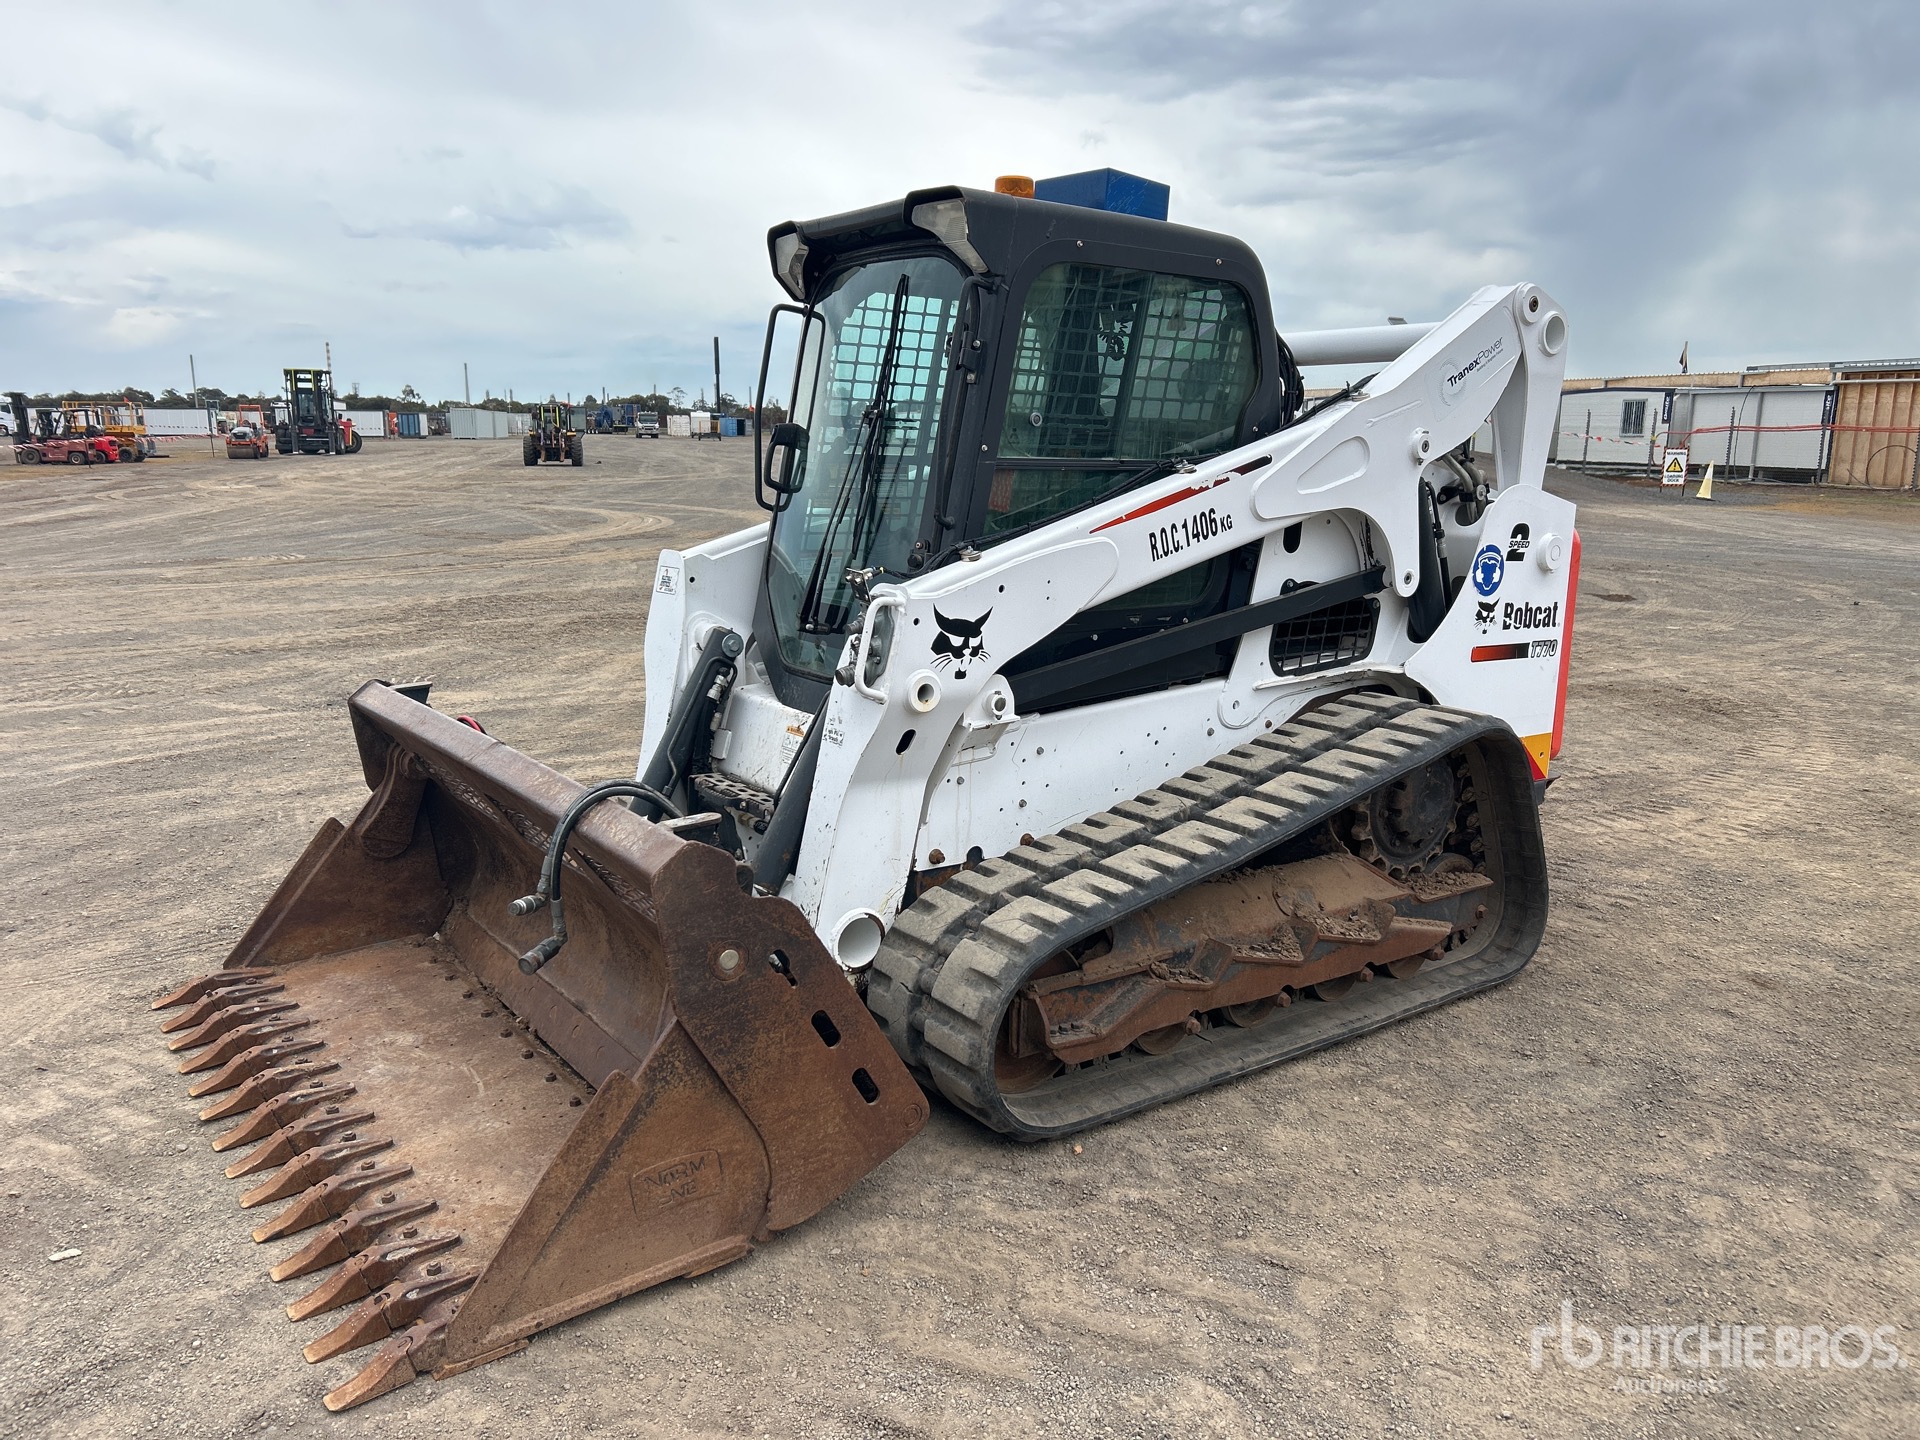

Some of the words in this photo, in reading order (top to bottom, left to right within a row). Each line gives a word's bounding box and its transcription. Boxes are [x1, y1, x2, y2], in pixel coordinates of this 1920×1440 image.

[1447, 336, 1503, 387] TranexPower
[1149, 523, 1184, 562] R.O.C.
[1182, 507, 1218, 548] 1406
[1220, 514, 1233, 532] KG
[1505, 522, 1530, 562] 2
[1508, 540, 1530, 549] SPEED
[1502, 602, 1559, 630] Bobcat
[1531, 640, 1558, 658] T770
[643, 1156, 706, 1187] NORM
